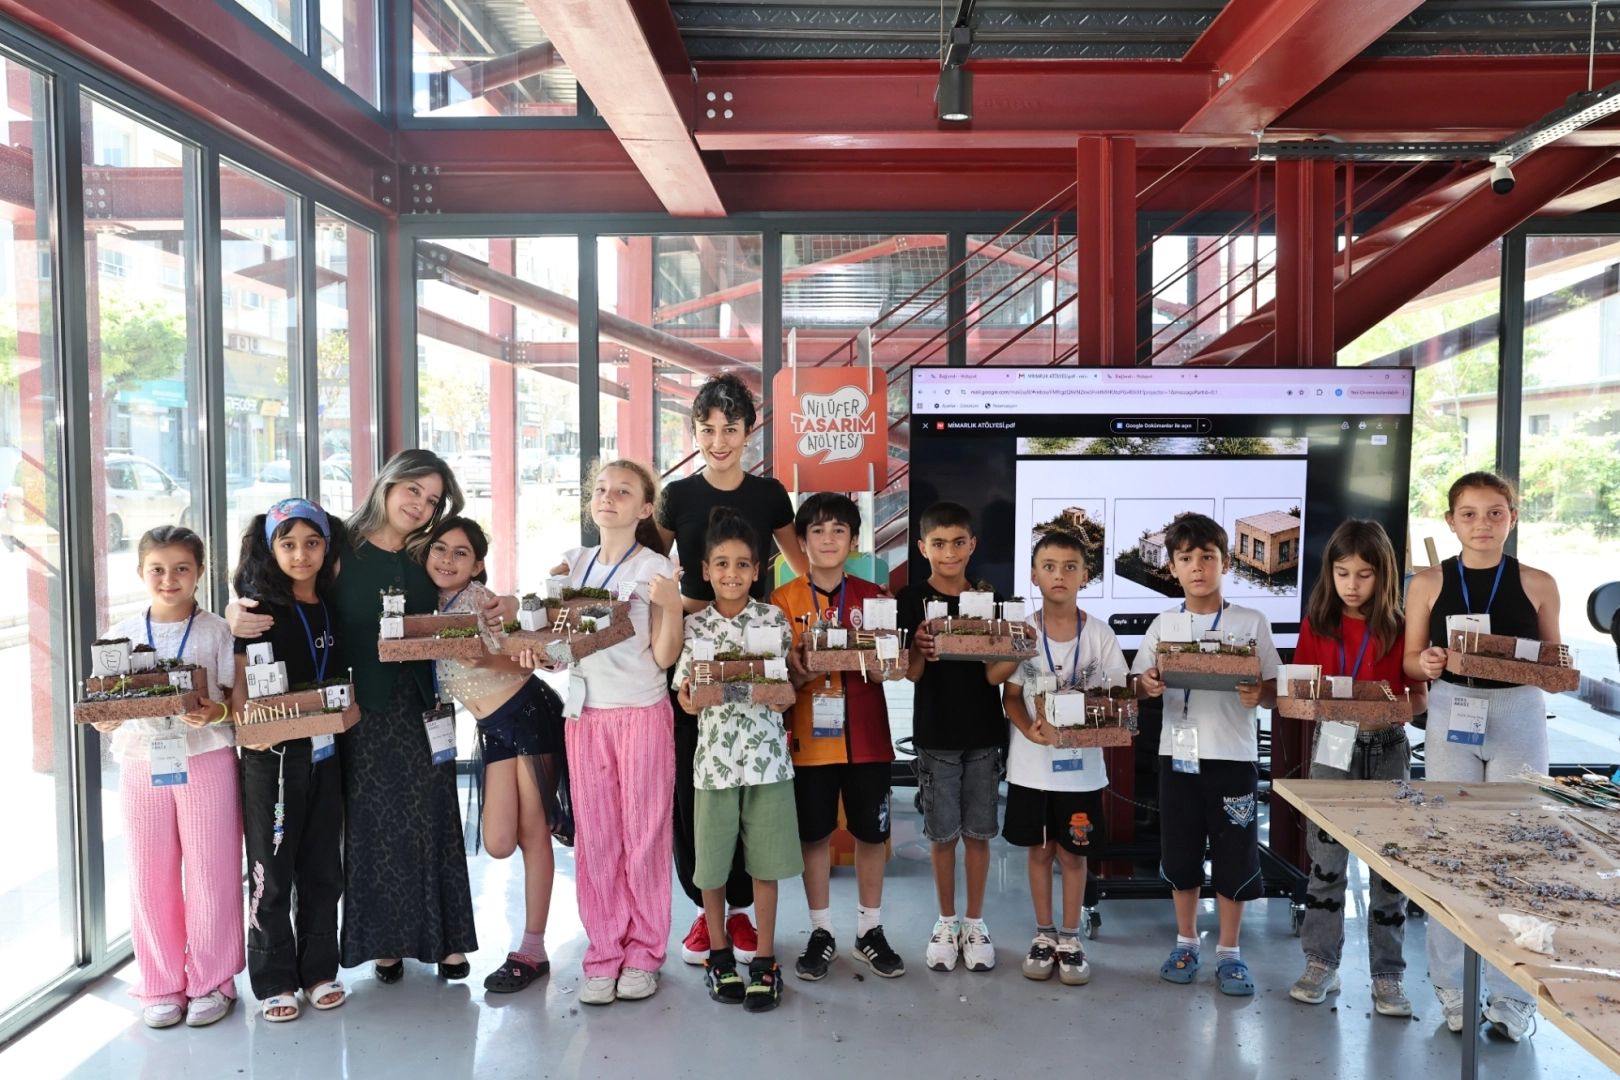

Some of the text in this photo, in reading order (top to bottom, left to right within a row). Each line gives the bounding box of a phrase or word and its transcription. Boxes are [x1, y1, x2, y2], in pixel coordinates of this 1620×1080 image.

[807, 399, 860, 418] NİLÜFER
[792, 413, 874, 432] TASARIM
[978, 421, 1016, 429] ATÖLYESİ.pdf
[808, 432, 860, 450] ATÖLYESİ
[1223, 792, 1254, 802] MICHIGAN
